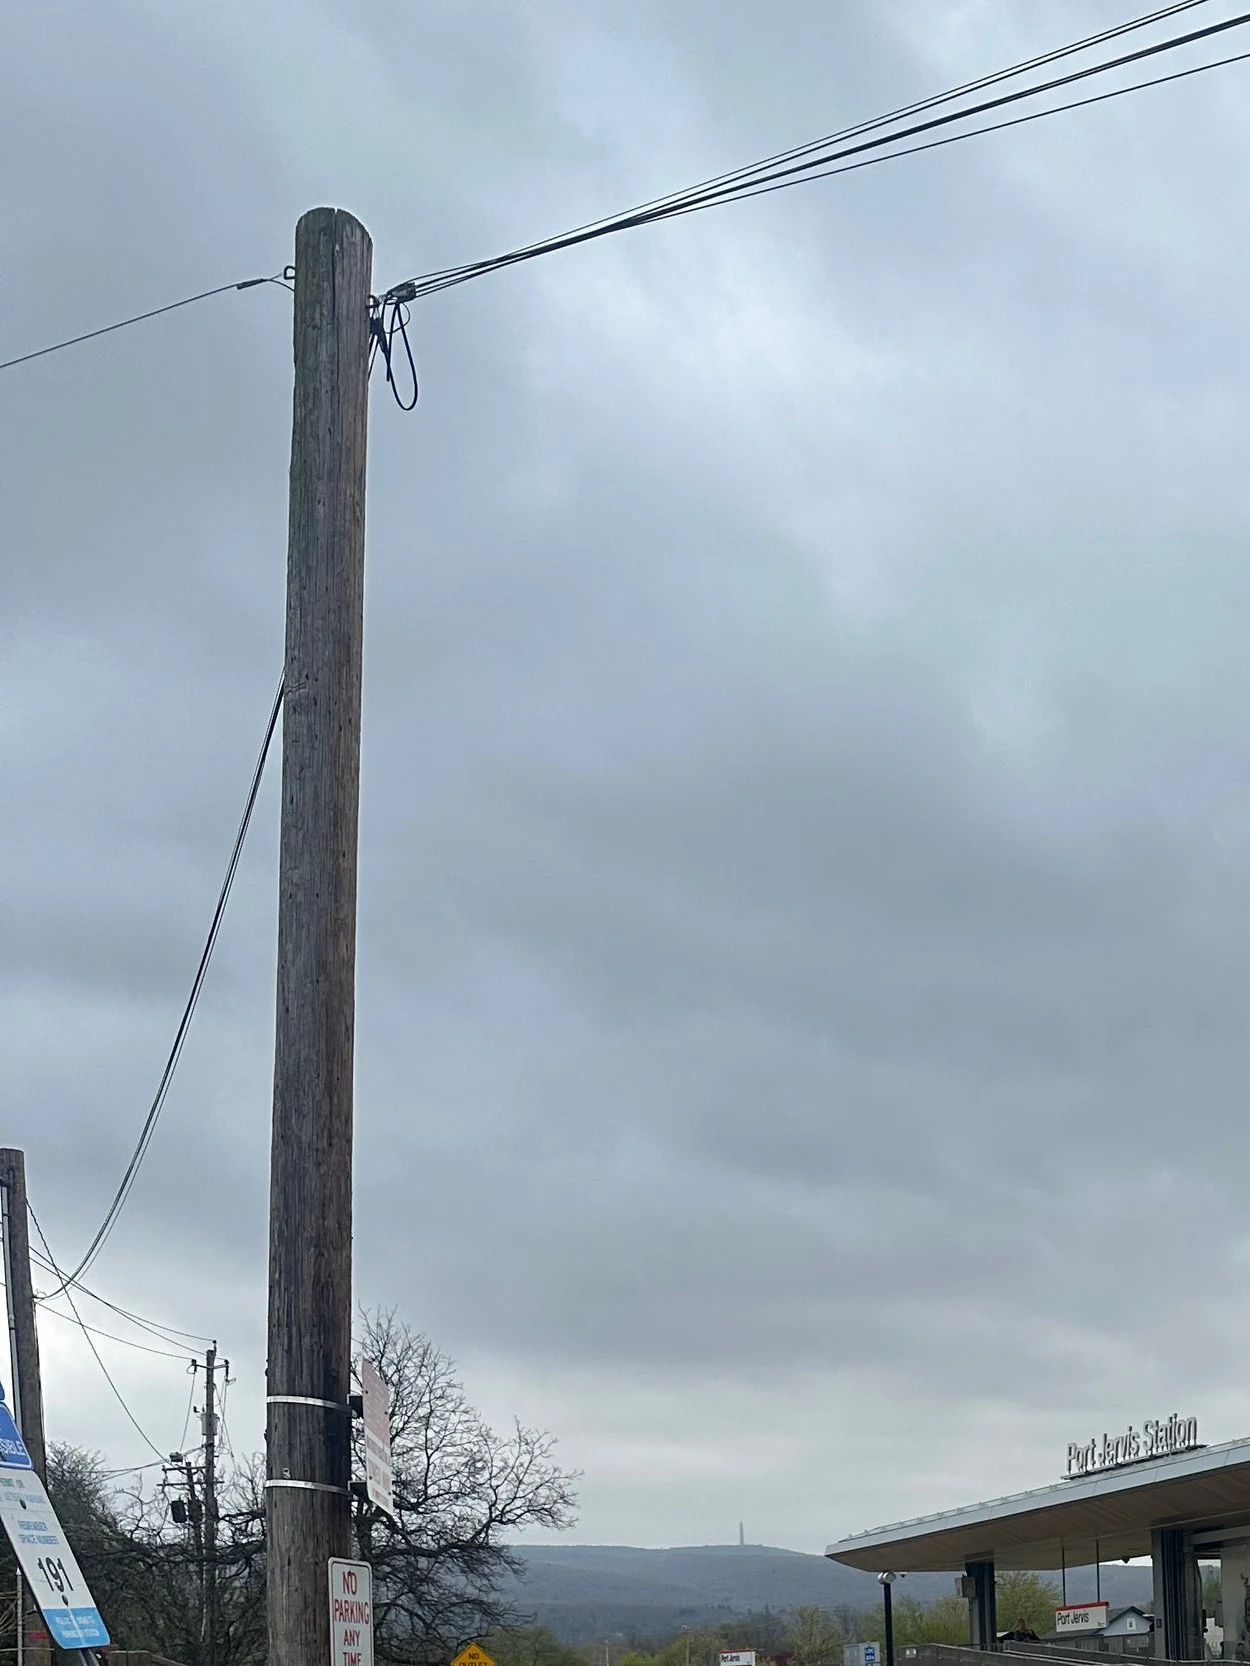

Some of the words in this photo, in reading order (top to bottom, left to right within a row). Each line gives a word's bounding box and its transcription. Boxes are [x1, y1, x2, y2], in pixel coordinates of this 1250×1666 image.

[1066, 1438, 1096, 1472] Port
[1098, 1425, 1140, 1464] Jervis
[1143, 1412, 1197, 1455] Station
[37, 1557, 74, 1593] 191
[342, 1570, 358, 1595] NO
[334, 1599, 370, 1625] PARKING
[1057, 1612, 1070, 1625] Port
[1071, 1610, 1089, 1624] Jervis
[343, 1629, 361, 1647] ANY
[468, 1652, 480, 1660] NO
[721, 1654, 729, 1662] Port
